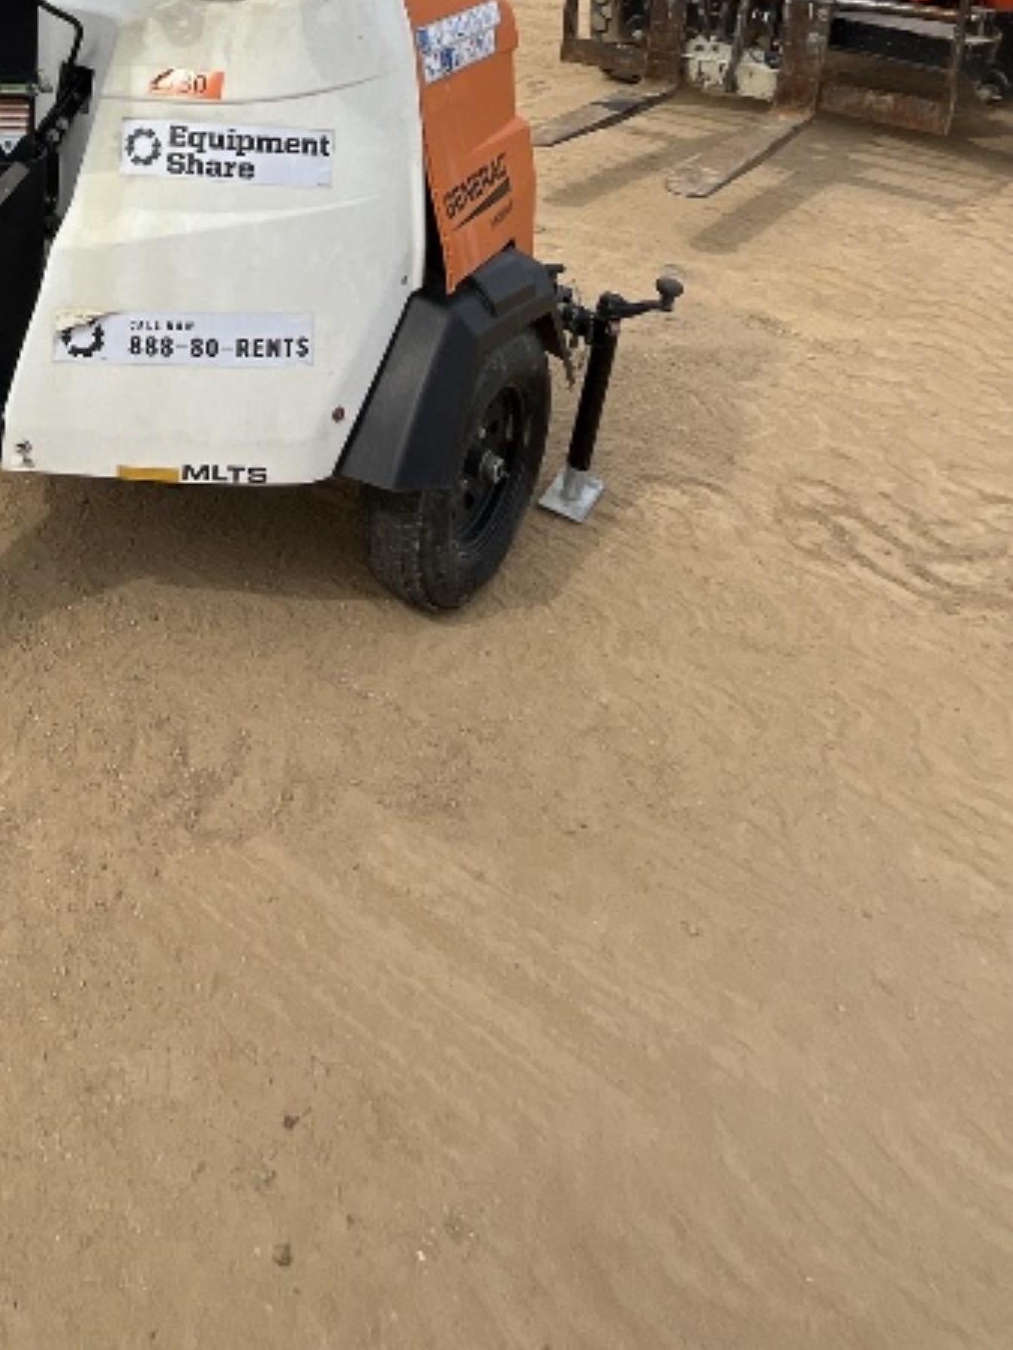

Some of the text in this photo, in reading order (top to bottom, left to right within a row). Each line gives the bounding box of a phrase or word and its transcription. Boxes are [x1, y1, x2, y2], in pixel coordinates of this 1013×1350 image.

[169, 124, 330, 157] Equipment
[166, 152, 255, 180] Share
[182, 464, 267, 484] MLTS
